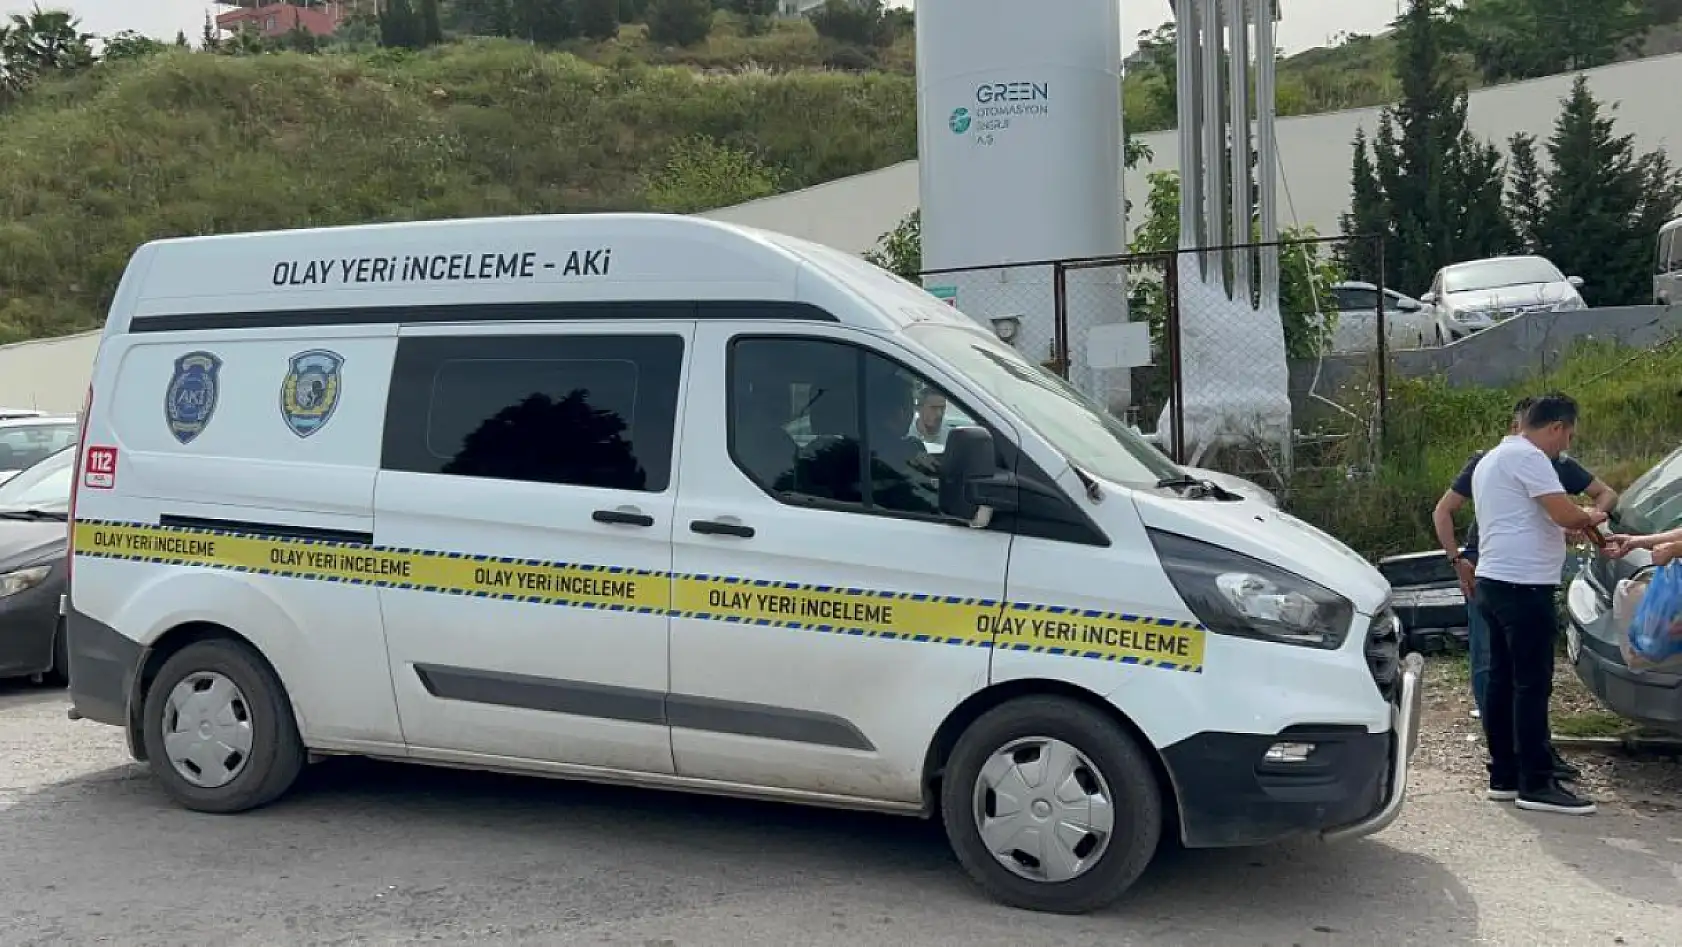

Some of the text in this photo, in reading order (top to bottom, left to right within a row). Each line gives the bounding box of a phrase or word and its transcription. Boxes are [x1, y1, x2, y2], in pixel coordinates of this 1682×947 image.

[977, 83, 1048, 103] GREEN
[273, 259, 335, 286] OLAY
[90, 451, 113, 471] 112
[94, 532, 123, 548] OLAY
[270, 548, 304, 566] OLAY
[474, 567, 513, 587] OLAY
[709, 588, 752, 610] OLAY
[976, 614, 1026, 636] OLAY
